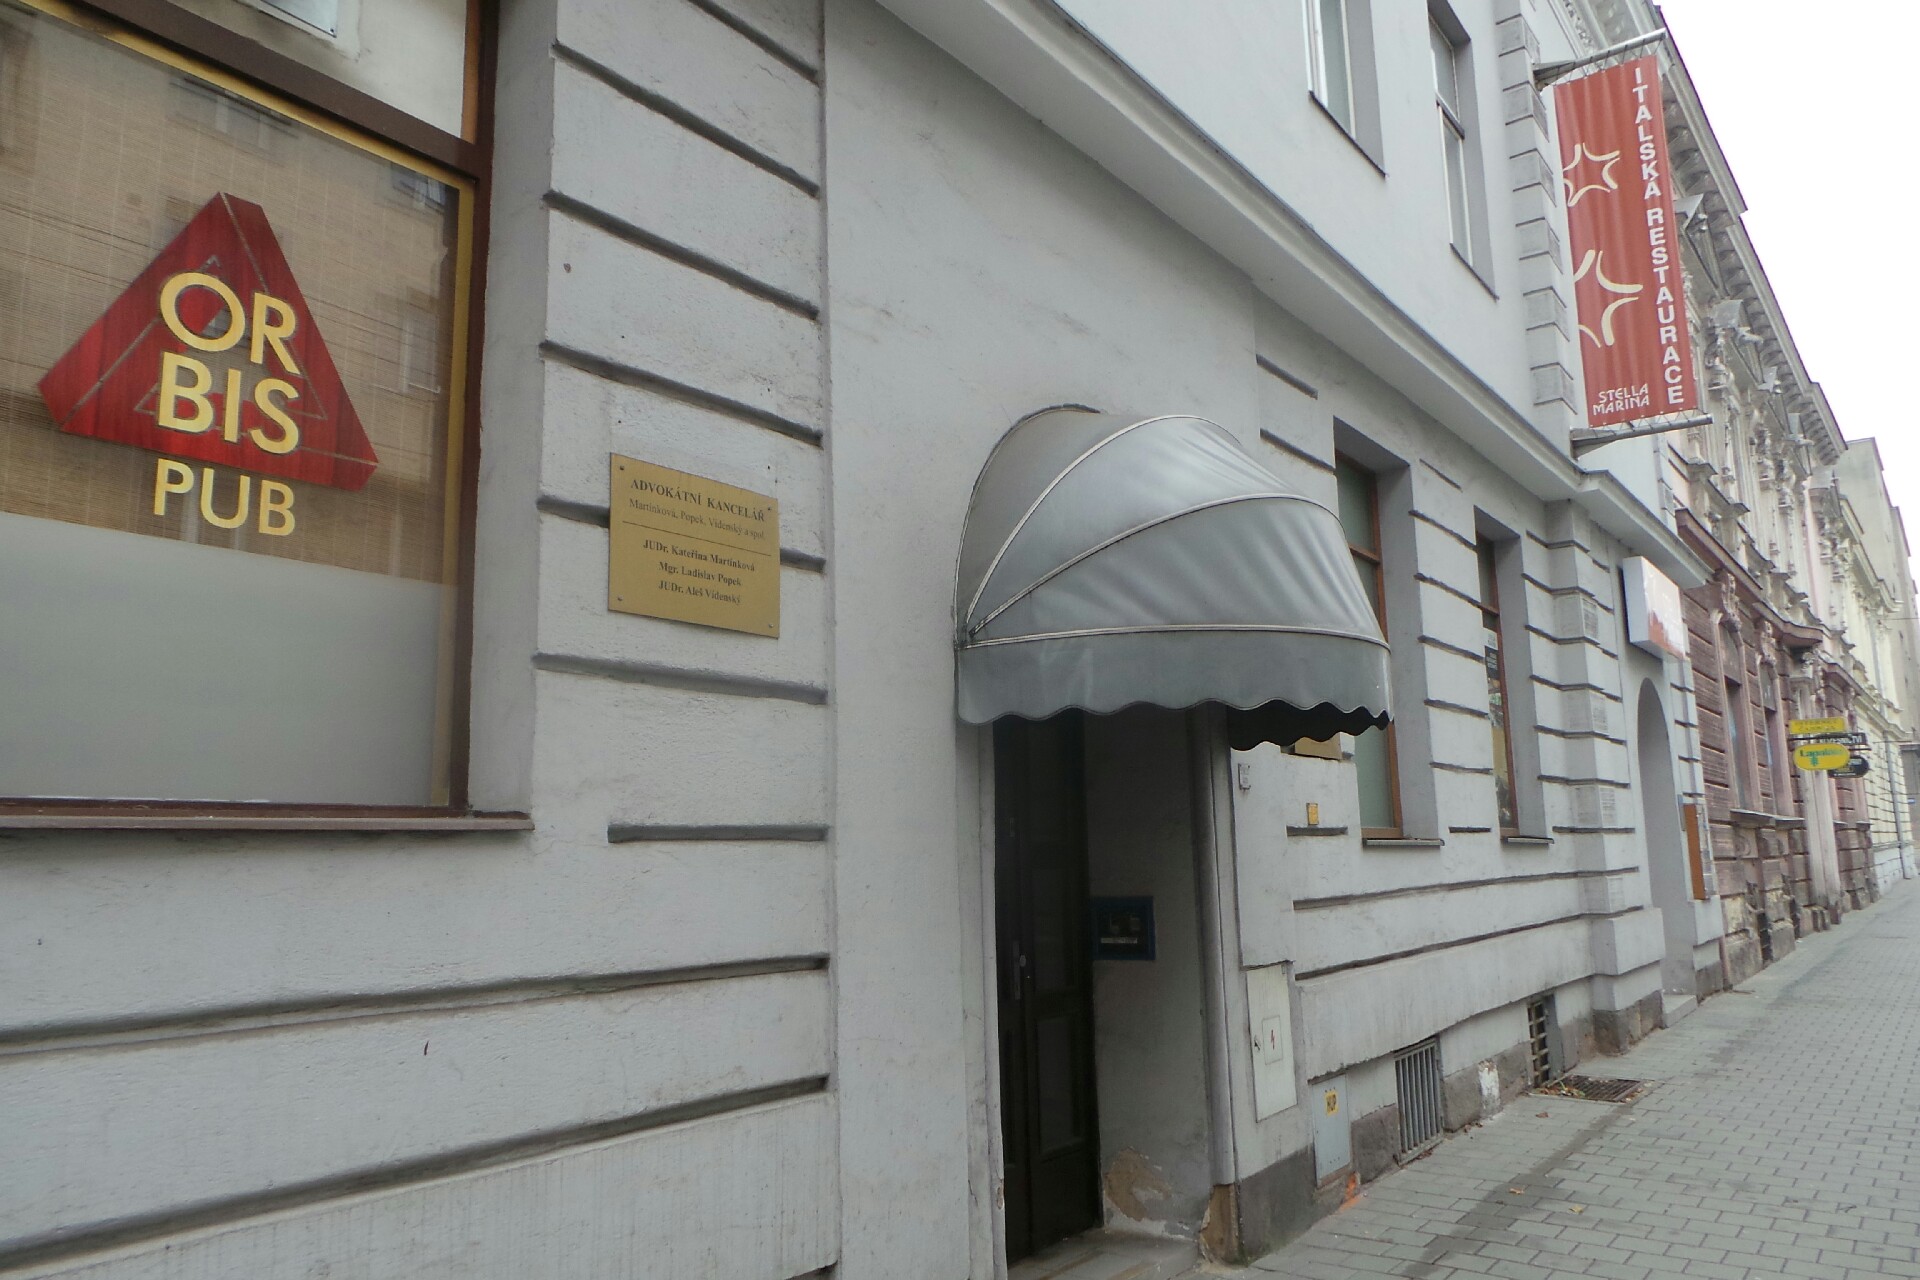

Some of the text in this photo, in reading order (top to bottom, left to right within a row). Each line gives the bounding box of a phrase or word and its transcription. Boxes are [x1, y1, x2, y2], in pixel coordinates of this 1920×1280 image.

[1646, 207, 1684, 404] RESTAURACE
[160, 272, 301, 374] OR
[158, 352, 299, 454] BIS
[1593, 394, 1650, 415] MARINA
[1598, 382, 1649, 404] STELLA
[153, 458, 296, 537] PUB
[631, 479, 765, 522] ADVOKÁTNÍ KANCELÁŘ
[643, 539, 669, 553] JUDr.
[671, 545, 708, 561] Kateřina
[658, 580, 684, 594] JUDr.
[686, 586, 703, 597] Aleš
[659, 561, 742, 586] Mgr. Ladislav Popek
